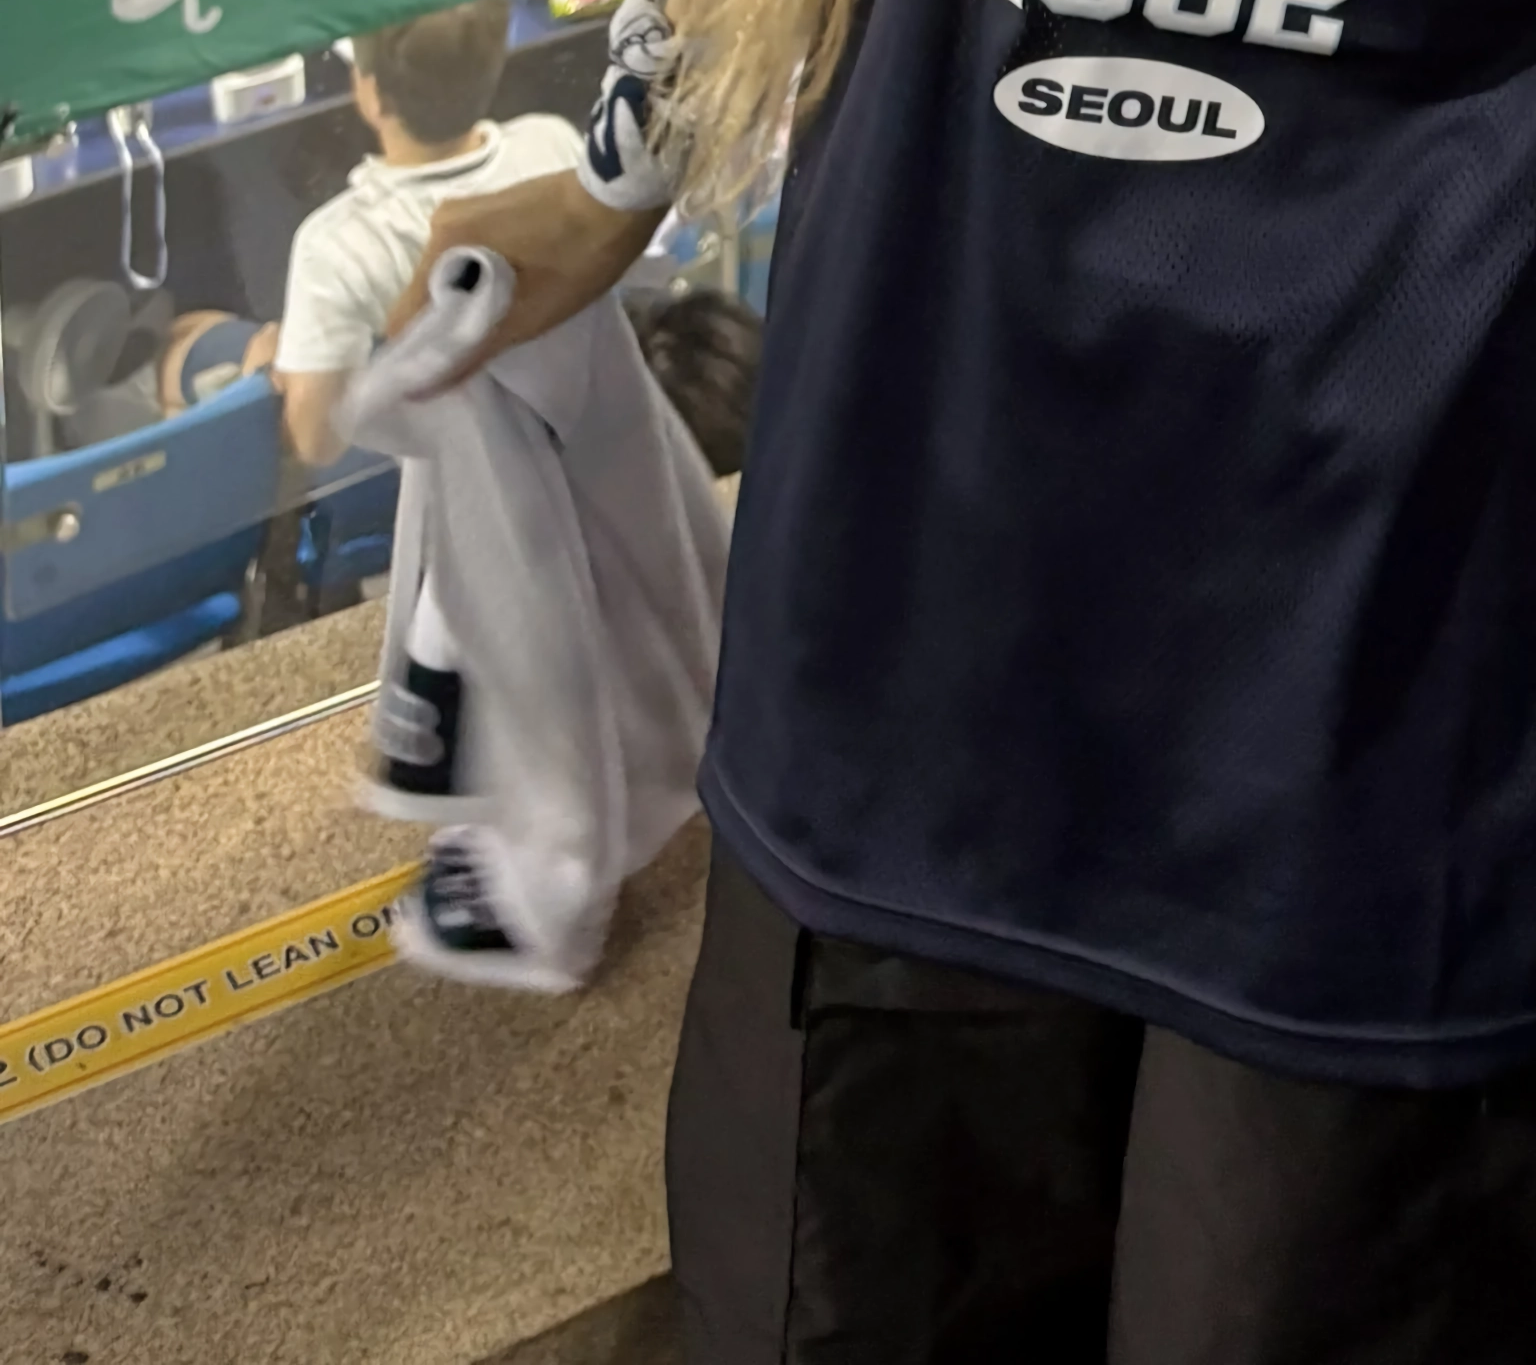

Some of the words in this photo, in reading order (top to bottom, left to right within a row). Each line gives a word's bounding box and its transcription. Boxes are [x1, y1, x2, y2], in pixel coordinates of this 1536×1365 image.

[1017, 77, 1239, 140] SEOUL
[28, 1023, 108, 1072] (DO
[121, 979, 209, 1033] NOT
[225, 929, 340, 992] LEAN
